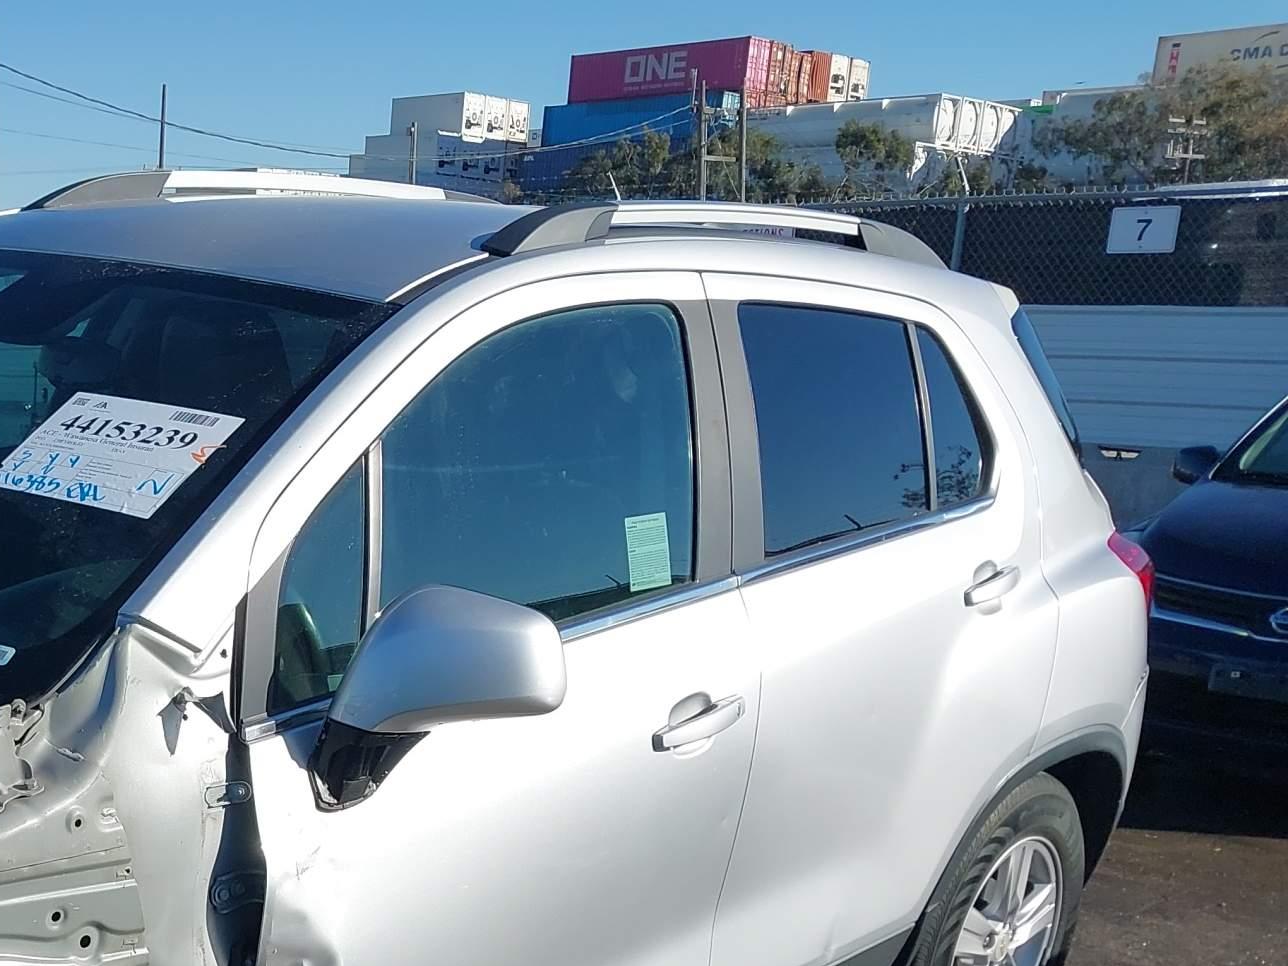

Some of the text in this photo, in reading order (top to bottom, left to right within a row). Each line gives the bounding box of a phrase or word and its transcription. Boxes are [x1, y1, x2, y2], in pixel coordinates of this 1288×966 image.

[624, 51, 689, 83] ONE
[1136, 218, 1153, 241] 7
[60, 414, 199, 449] 44153239
